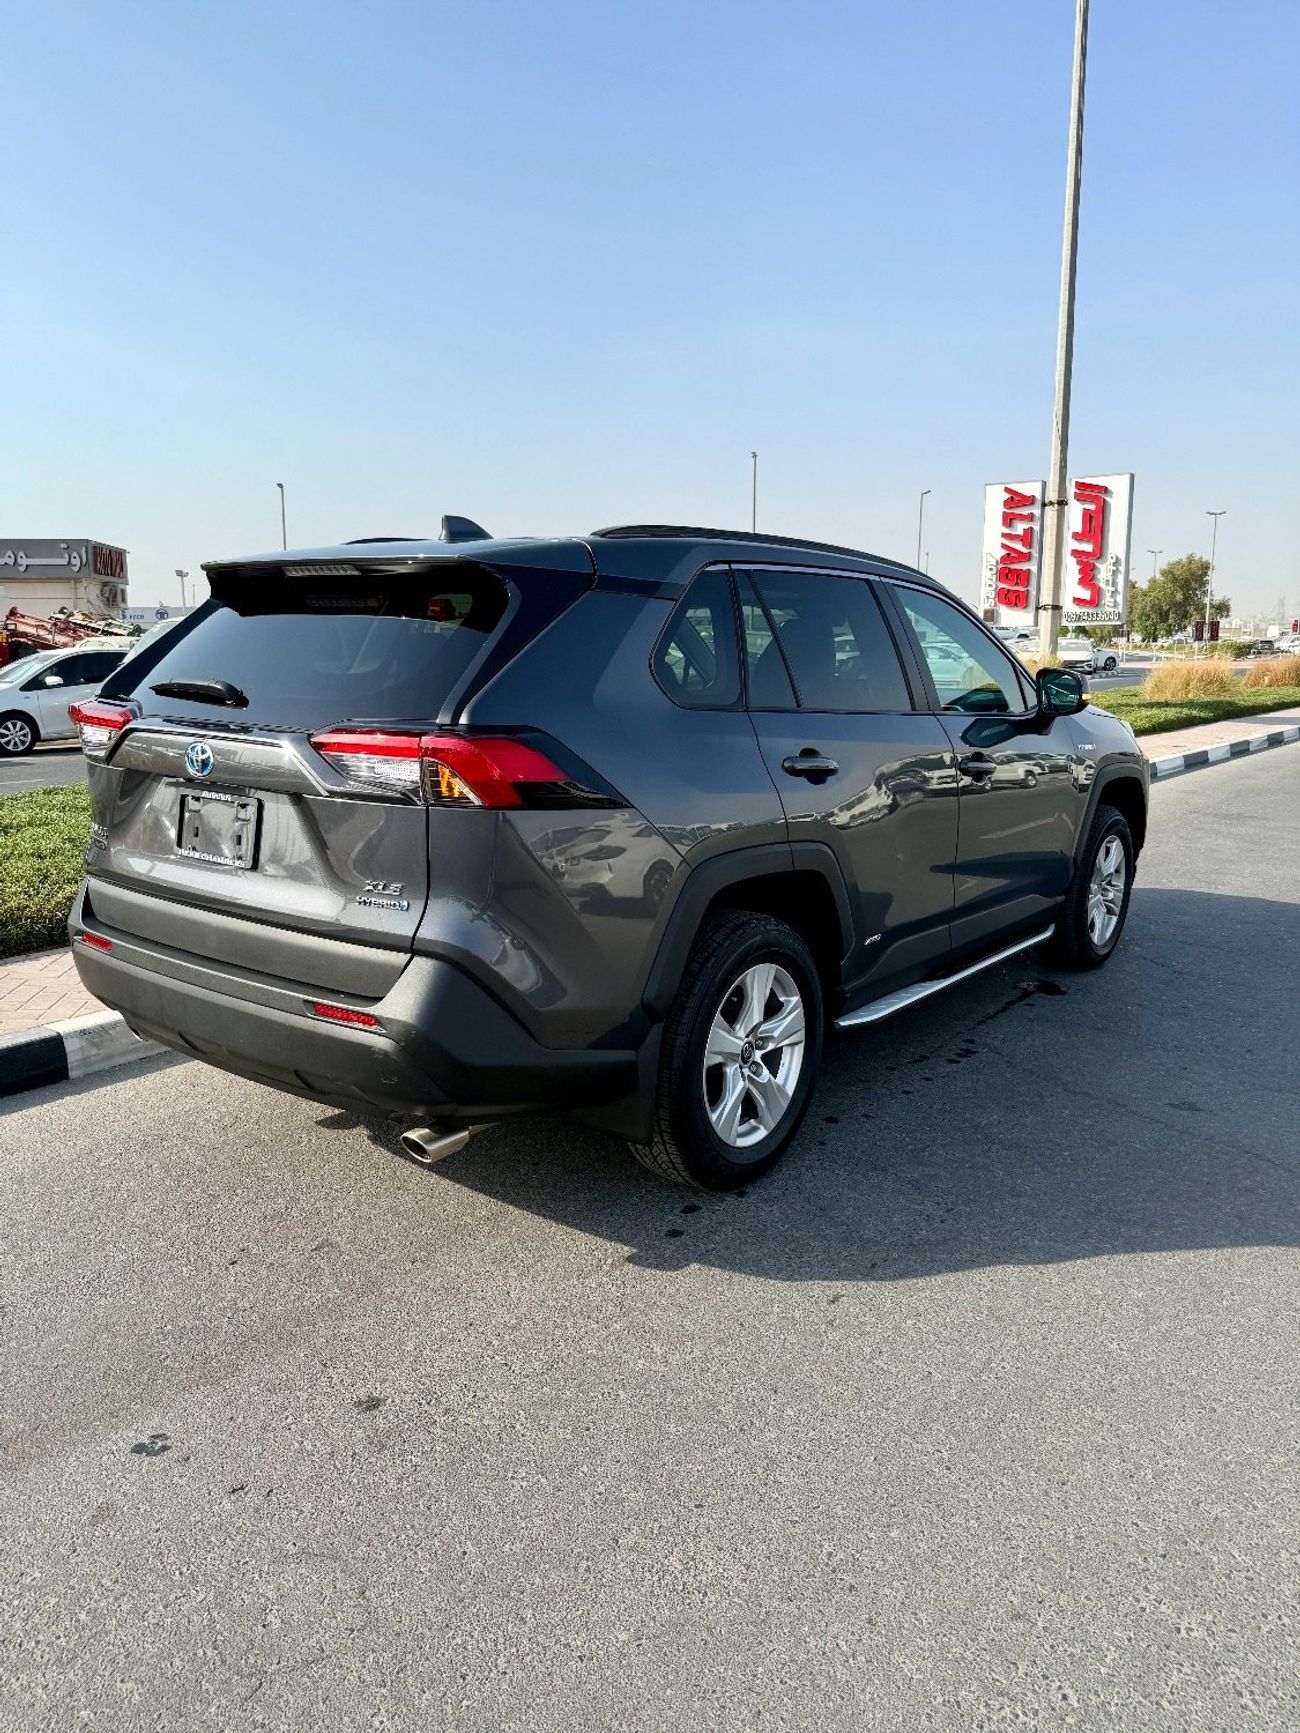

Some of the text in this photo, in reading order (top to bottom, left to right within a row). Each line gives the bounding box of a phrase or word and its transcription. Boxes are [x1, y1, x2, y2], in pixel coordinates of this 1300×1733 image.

[0, 543, 87, 573] اوتوم
[997, 486, 1035, 609] ALTASS
[983, 553, 998, 607] MOTORS
[355, 895, 401, 911] HYBRID
[363, 880, 403, 896] XLE
